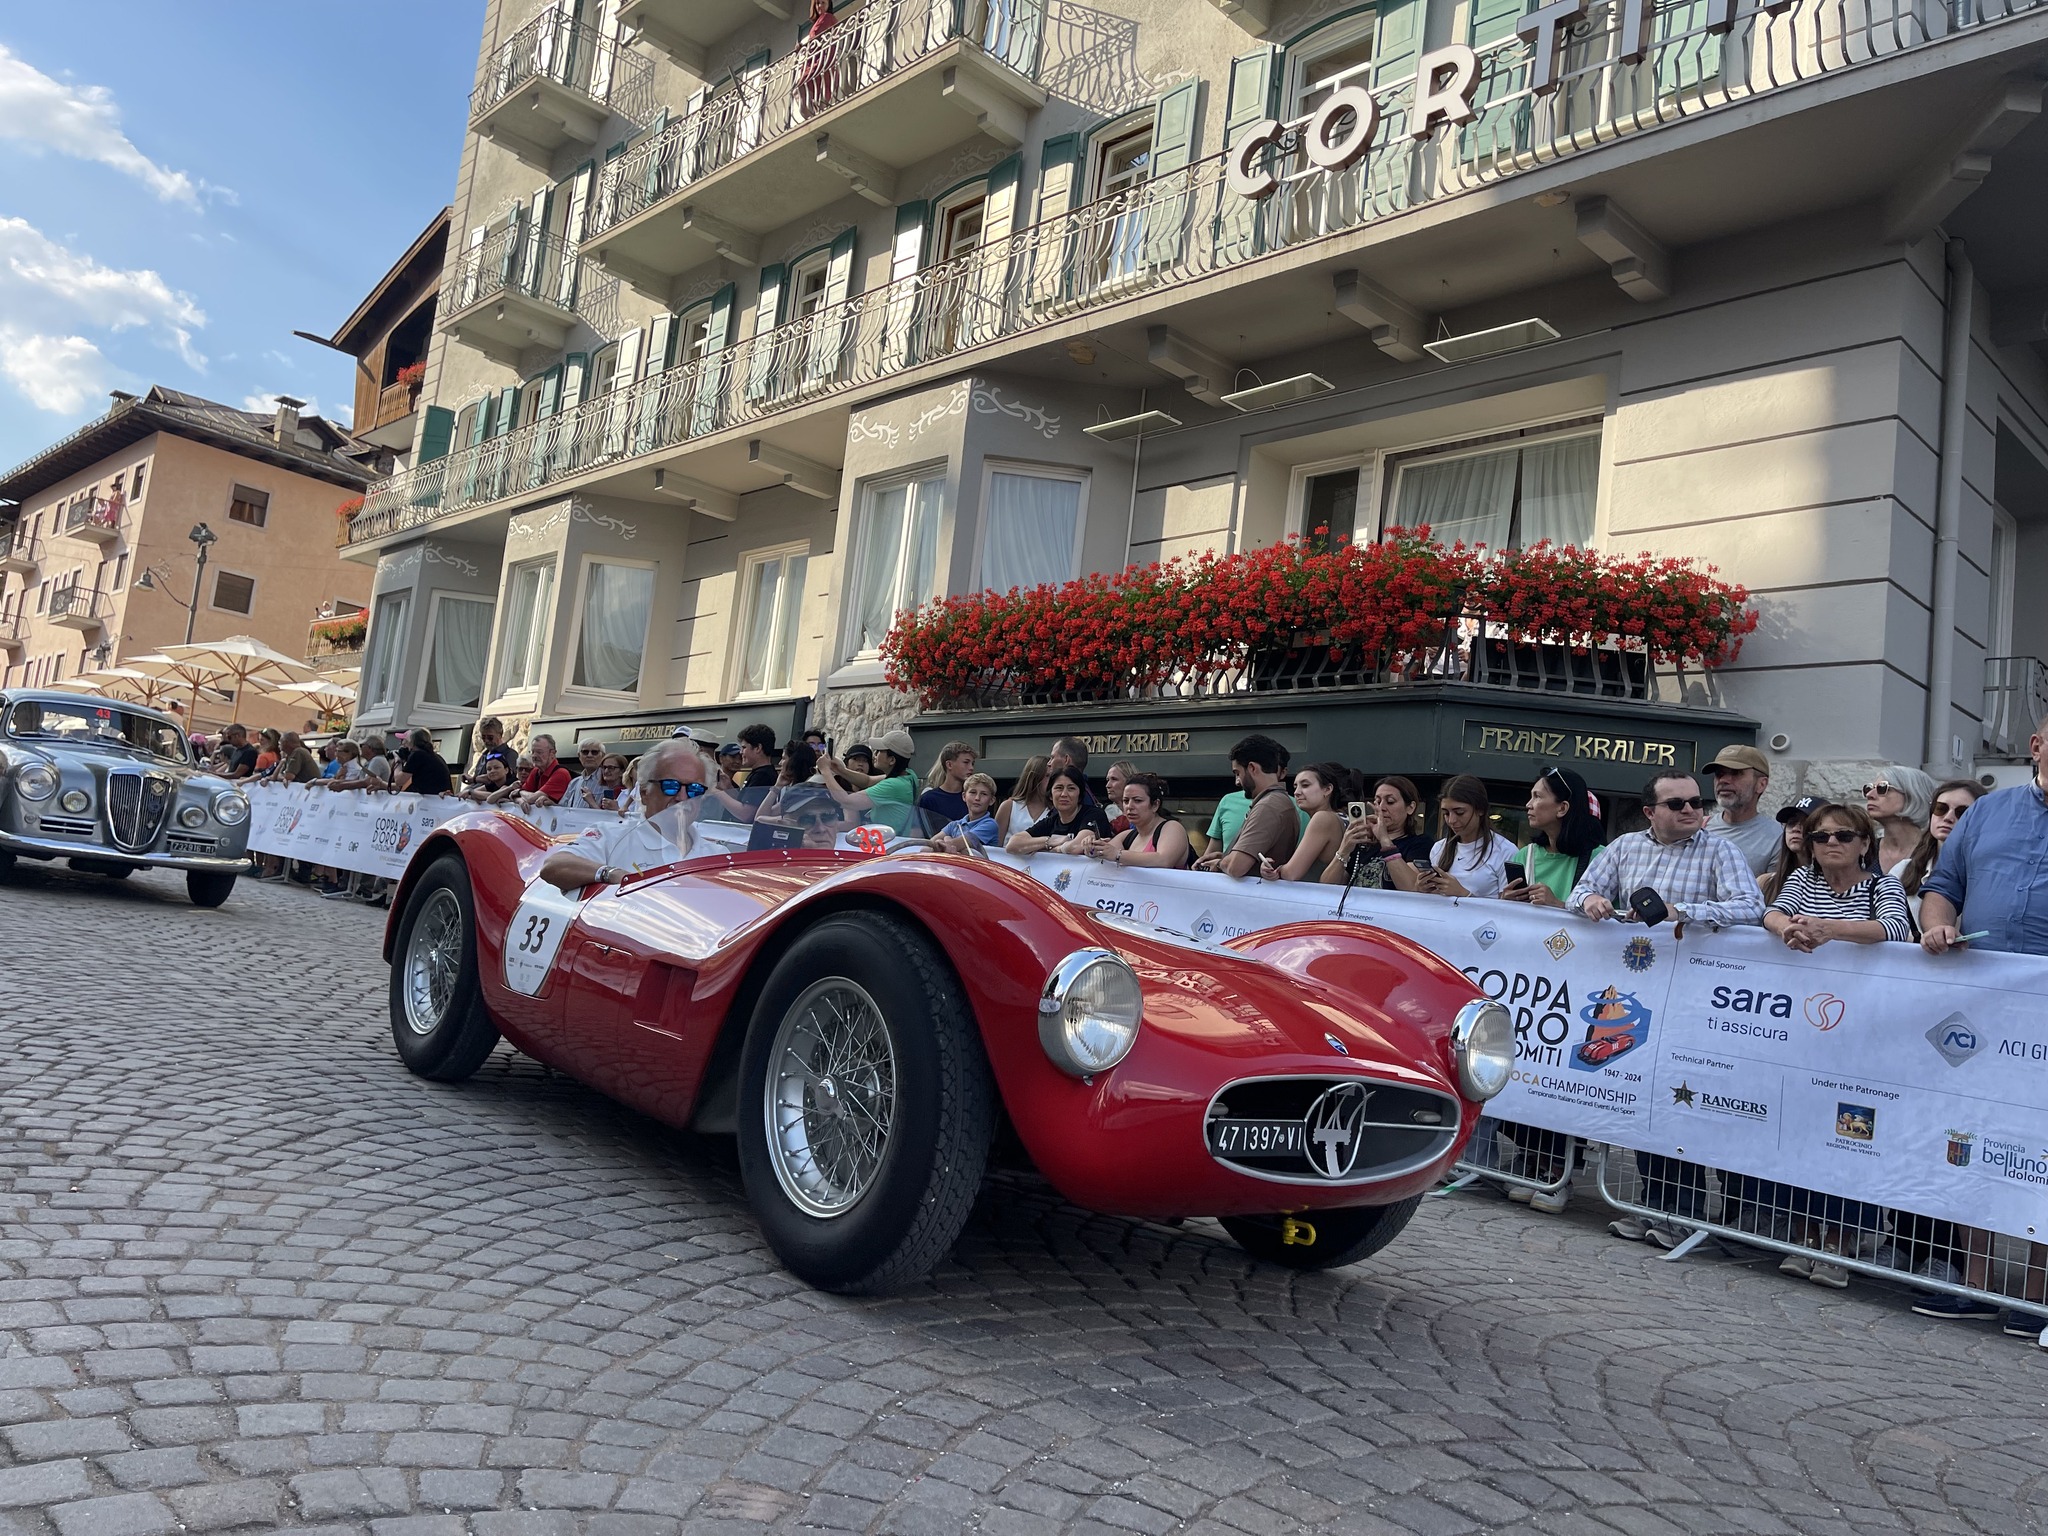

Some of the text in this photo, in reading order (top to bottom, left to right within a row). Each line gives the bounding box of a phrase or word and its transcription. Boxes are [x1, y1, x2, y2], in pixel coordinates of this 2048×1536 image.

[96, 708, 110, 719] 43
[620, 727, 644, 740] FRANZ
[1074, 733, 1189, 753] RANZ KRALER
[1480, 726, 1675, 767] FRANZ KRALER
[376, 817, 399, 833] COPPA
[422, 817, 435, 827] sara
[372, 830, 397, 846] D'ORO
[856, 826, 887, 855] 33
[1096, 899, 1135, 917] sara
[519, 915, 550, 954] 33
[1689, 957, 1746, 972] Official Sponsor
[1710, 985, 1793, 1019] sara
[1707, 1016, 1788, 1041] ti assicura
[1999, 1039, 2026, 1057] ACI
[1671, 1052, 1734, 1070] Technical Partner
[1811, 1077, 1900, 1100] Under the Patronage
[1527, 1088, 1557, 1100] Campionato
[1557, 1094, 1576, 1103] Italiano
[1576, 1098, 1594, 1108] Grandi
[1594, 1102, 1610, 1111] Eventi
[1620, 1107, 1636, 1116] Sport
[1701, 1092, 1767, 1115] RANGERS
[1218, 1126, 1281, 1151] 471397
[1835, 1137, 1873, 1150] PATROCINIO
[1983, 1137, 2026, 1154] Provincia
[1825, 1142, 1850, 1151] REGIONE
[1858, 1148, 1881, 1157] VENETO
[1982, 1146, 2047, 1177] belluno
